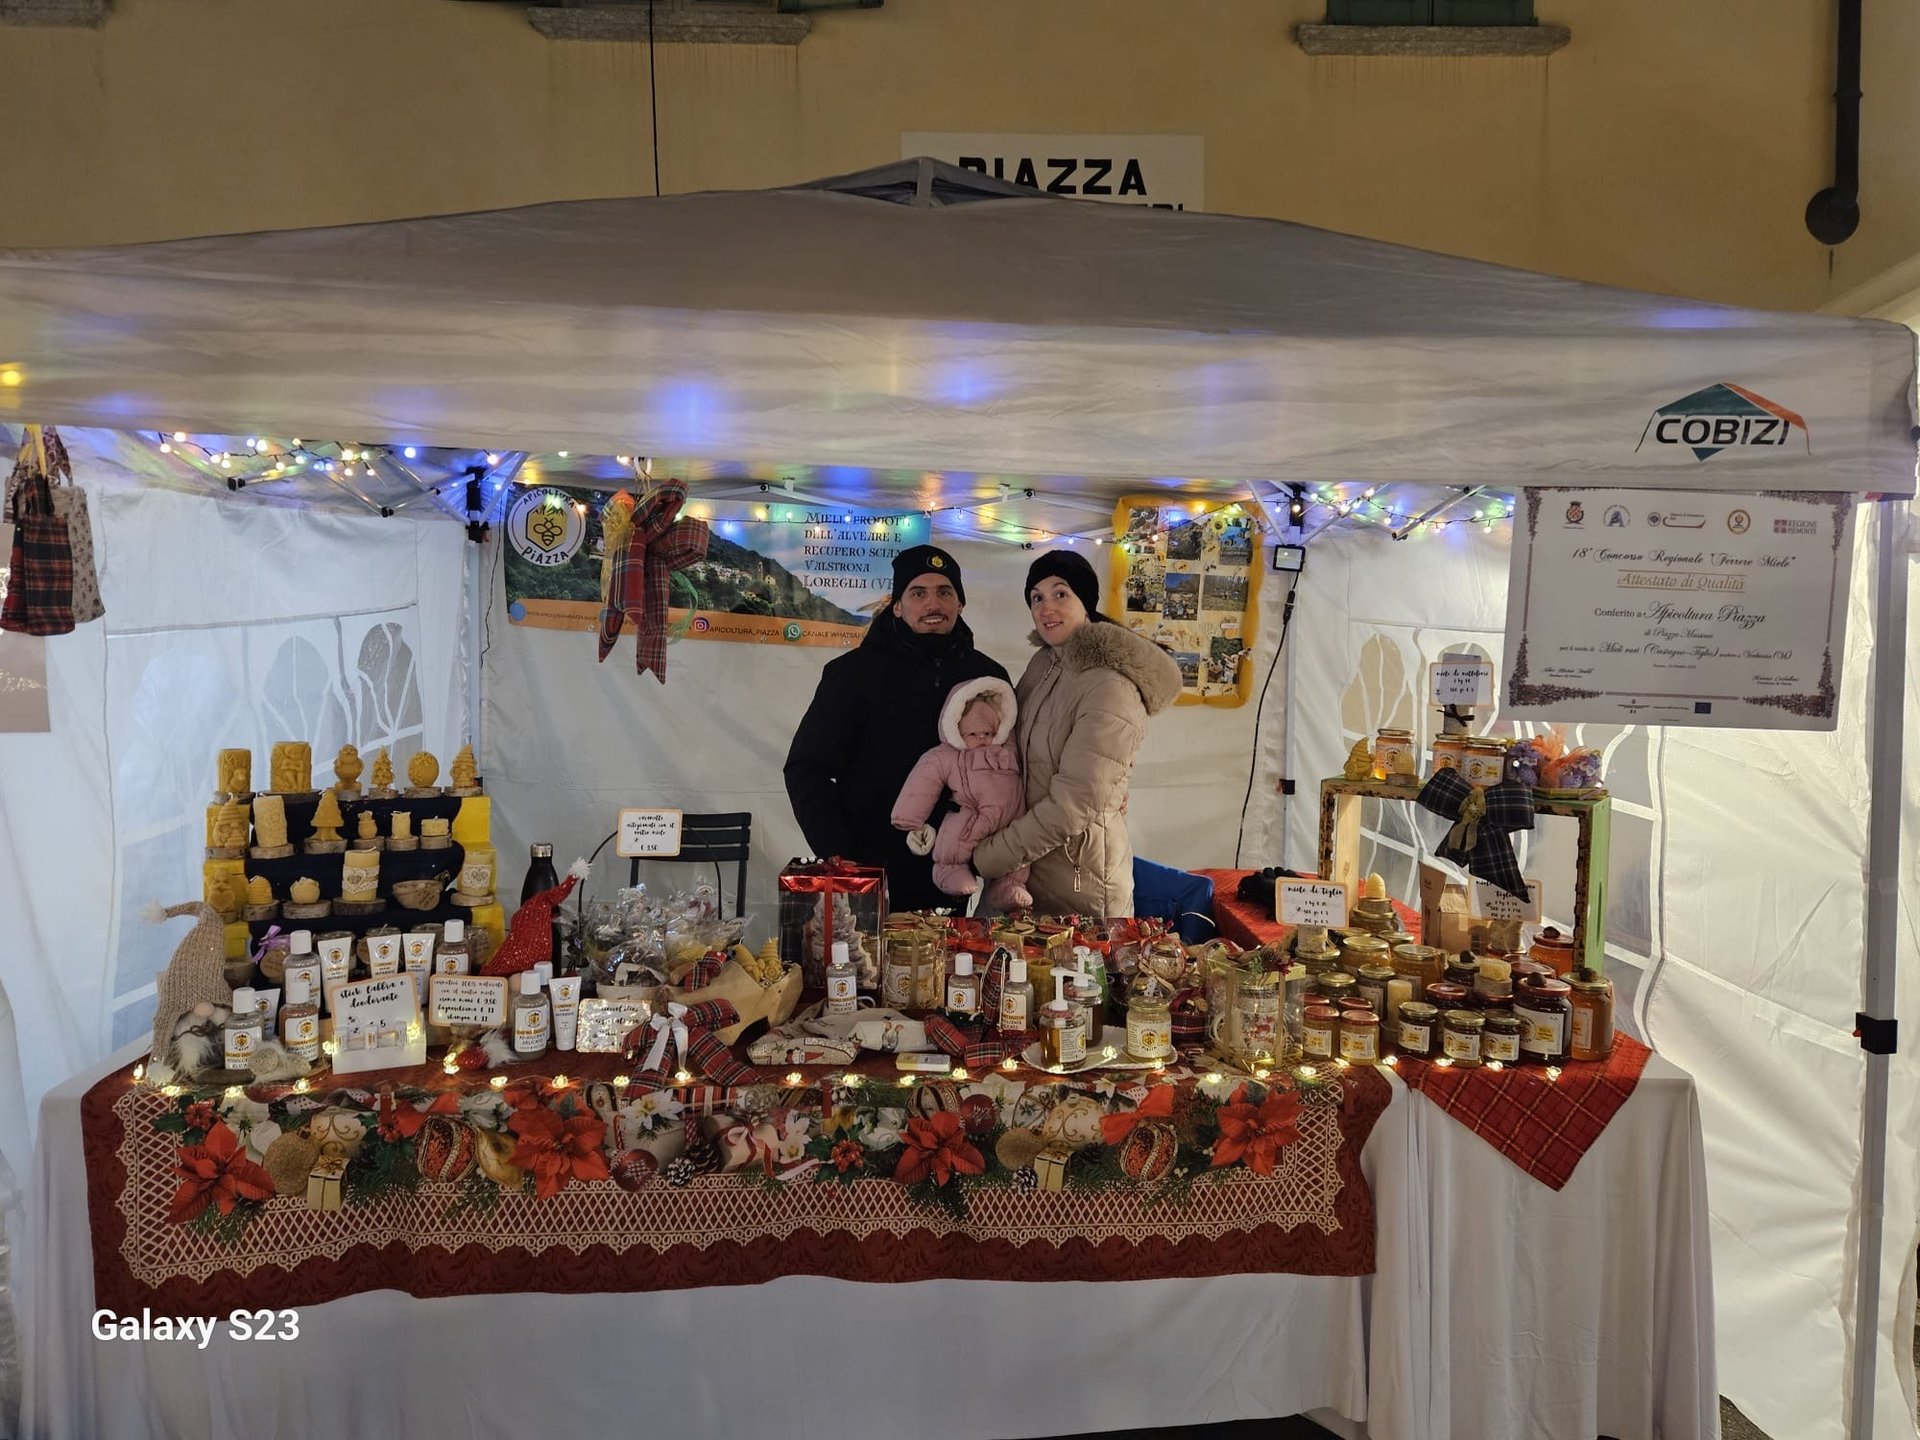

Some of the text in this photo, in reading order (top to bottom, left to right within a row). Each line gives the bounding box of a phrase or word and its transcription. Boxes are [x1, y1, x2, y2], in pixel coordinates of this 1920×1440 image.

[1656, 418, 1790, 445] COBIZI
[804, 529, 901, 542] DELL'ALVEARE E
[804, 545, 866, 557] RECUPERO
[1594, 548, 1643, 562] Concorso
[1648, 550, 1703, 566] Regionale
[804, 560, 870, 572] VALSTRONA
[803, 575, 866, 588] LOREGLIA
[1617, 573, 1677, 587] Attestato
[1681, 573, 1694, 588] di
[1594, 608, 1635, 617] Conferito
[1644, 600, 1713, 624] Apicoltura
[1717, 604, 1766, 630] Piazza
[1288, 885, 1343, 898] miele di tiglio
[340, 987, 360, 999] stick
[366, 981, 396, 994] labbra
[350, 992, 398, 1008] deodorante
